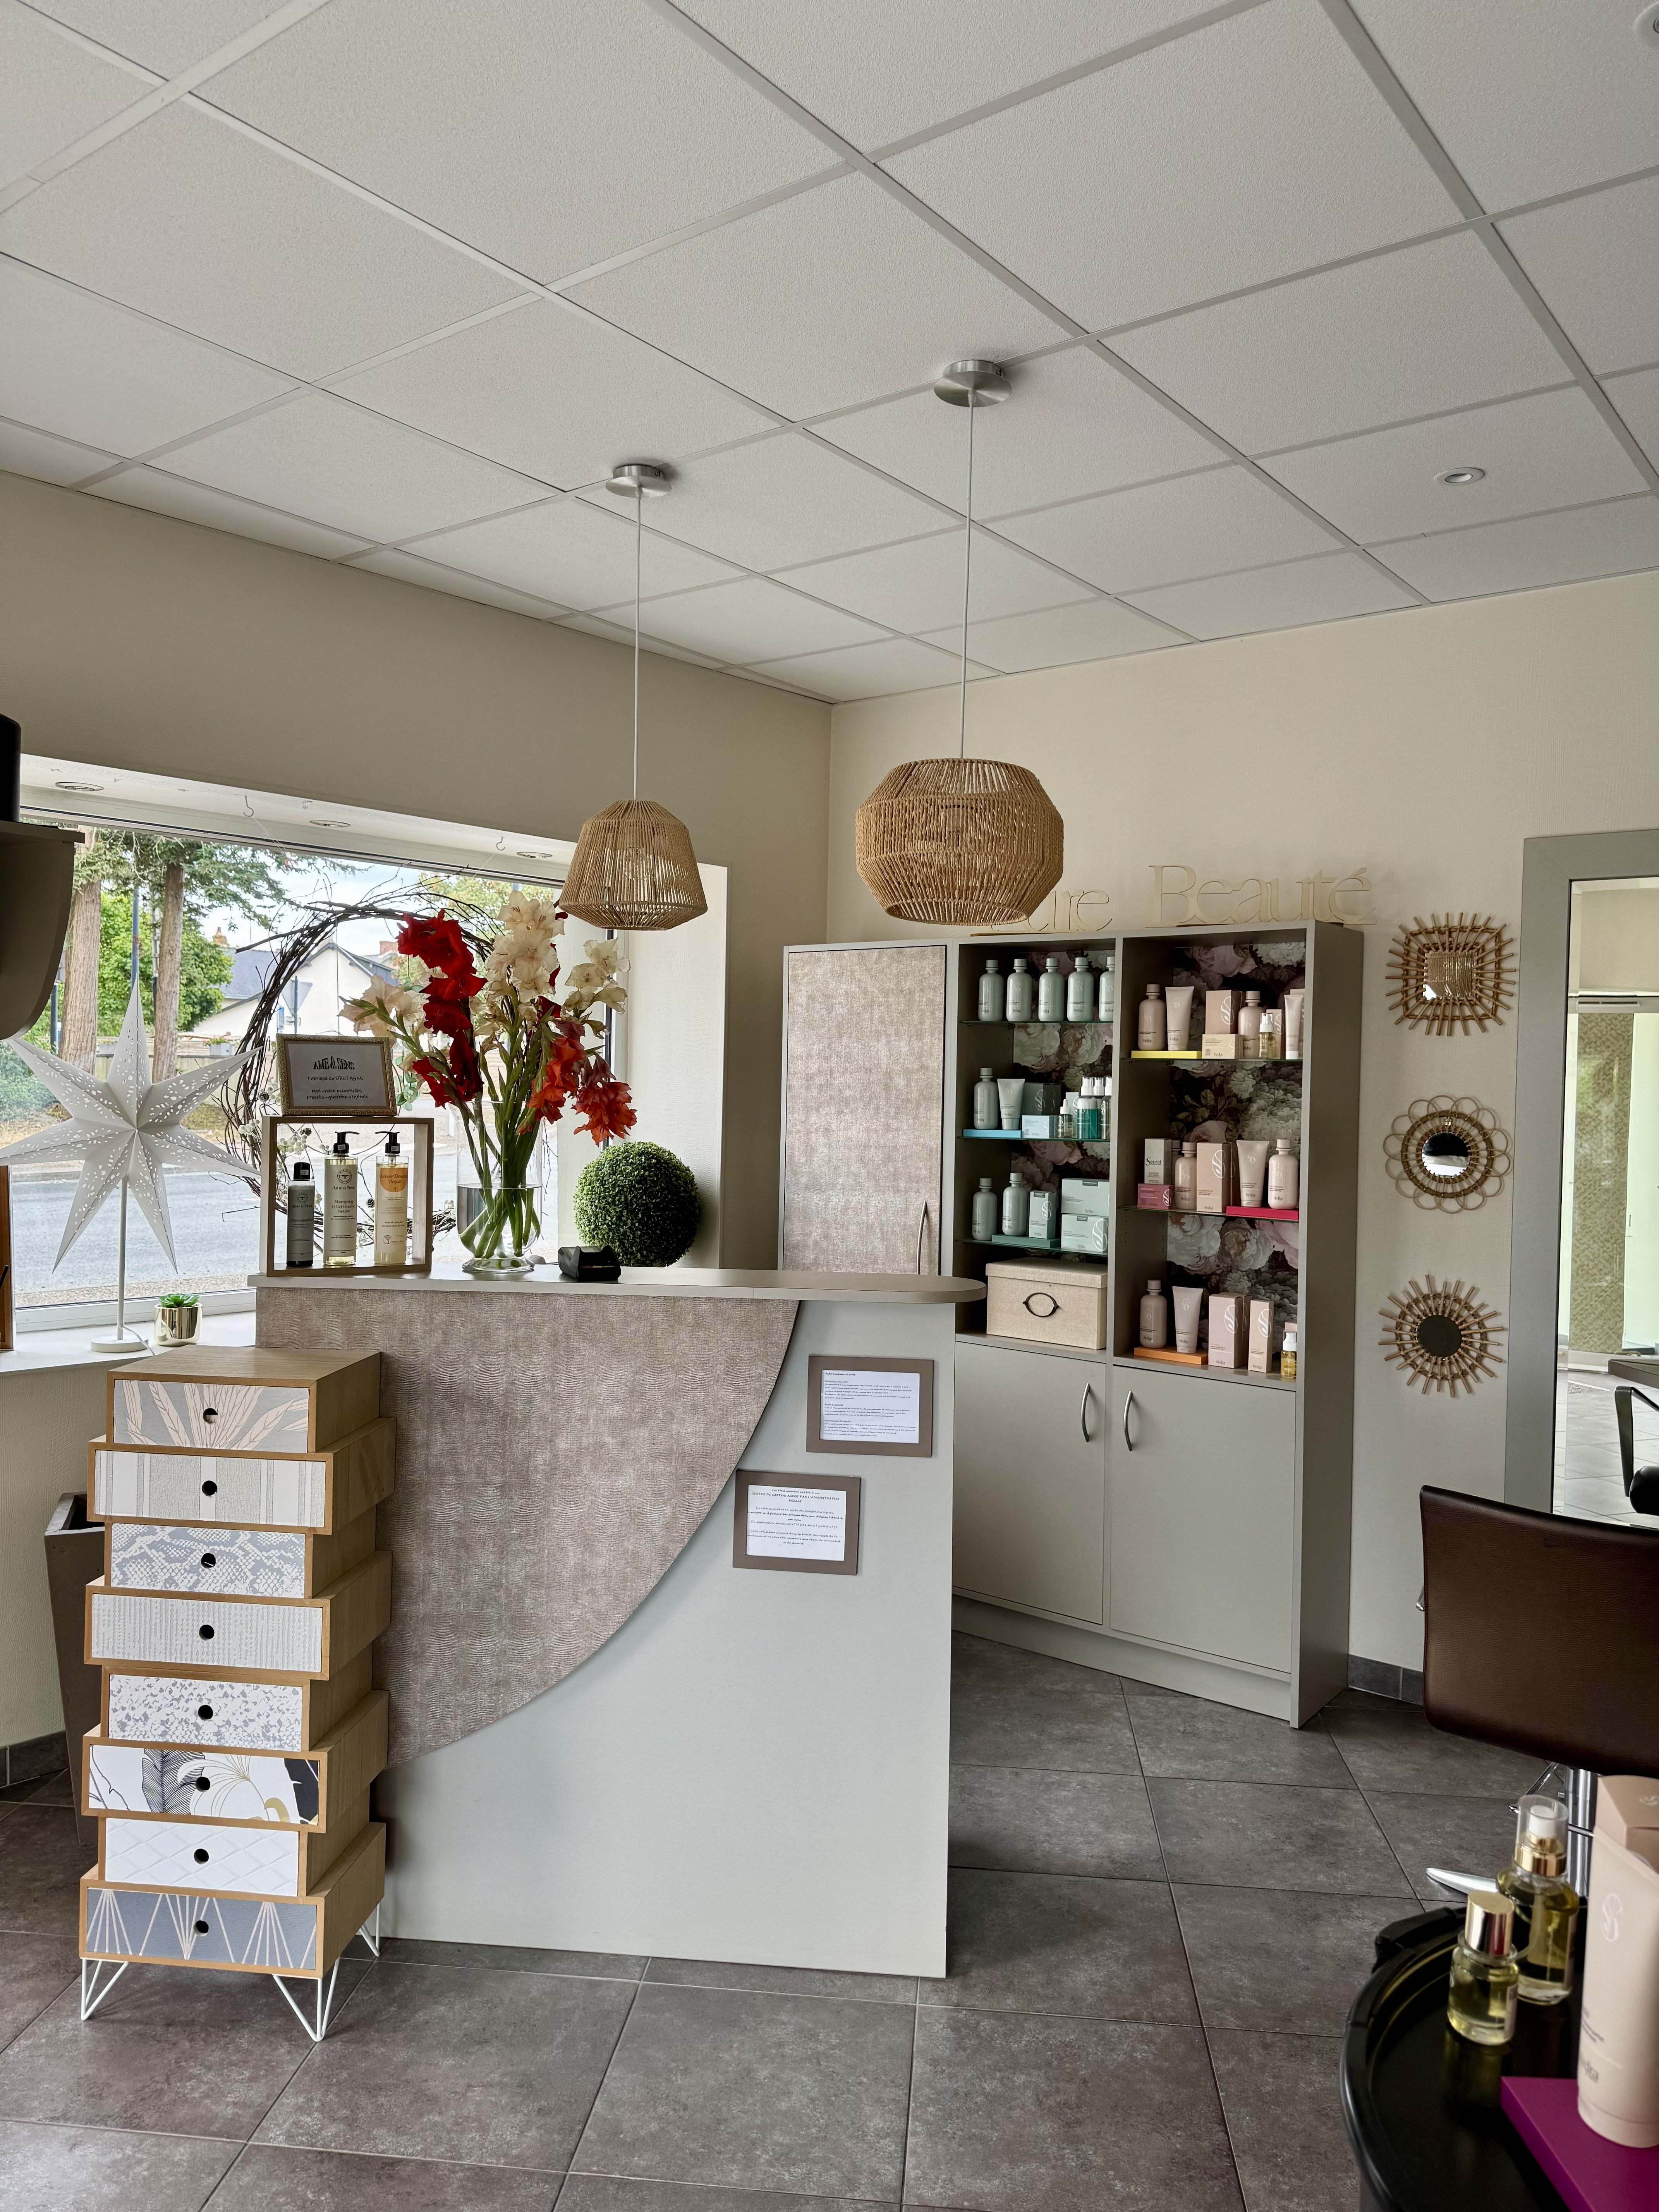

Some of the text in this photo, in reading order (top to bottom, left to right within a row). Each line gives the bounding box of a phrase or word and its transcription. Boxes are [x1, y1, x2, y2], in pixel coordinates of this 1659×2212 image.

[1145, 864, 1377, 928] Beauté
[330, 1056, 337, 1069] &
[1146, 1157, 1162, 1166] Secret
